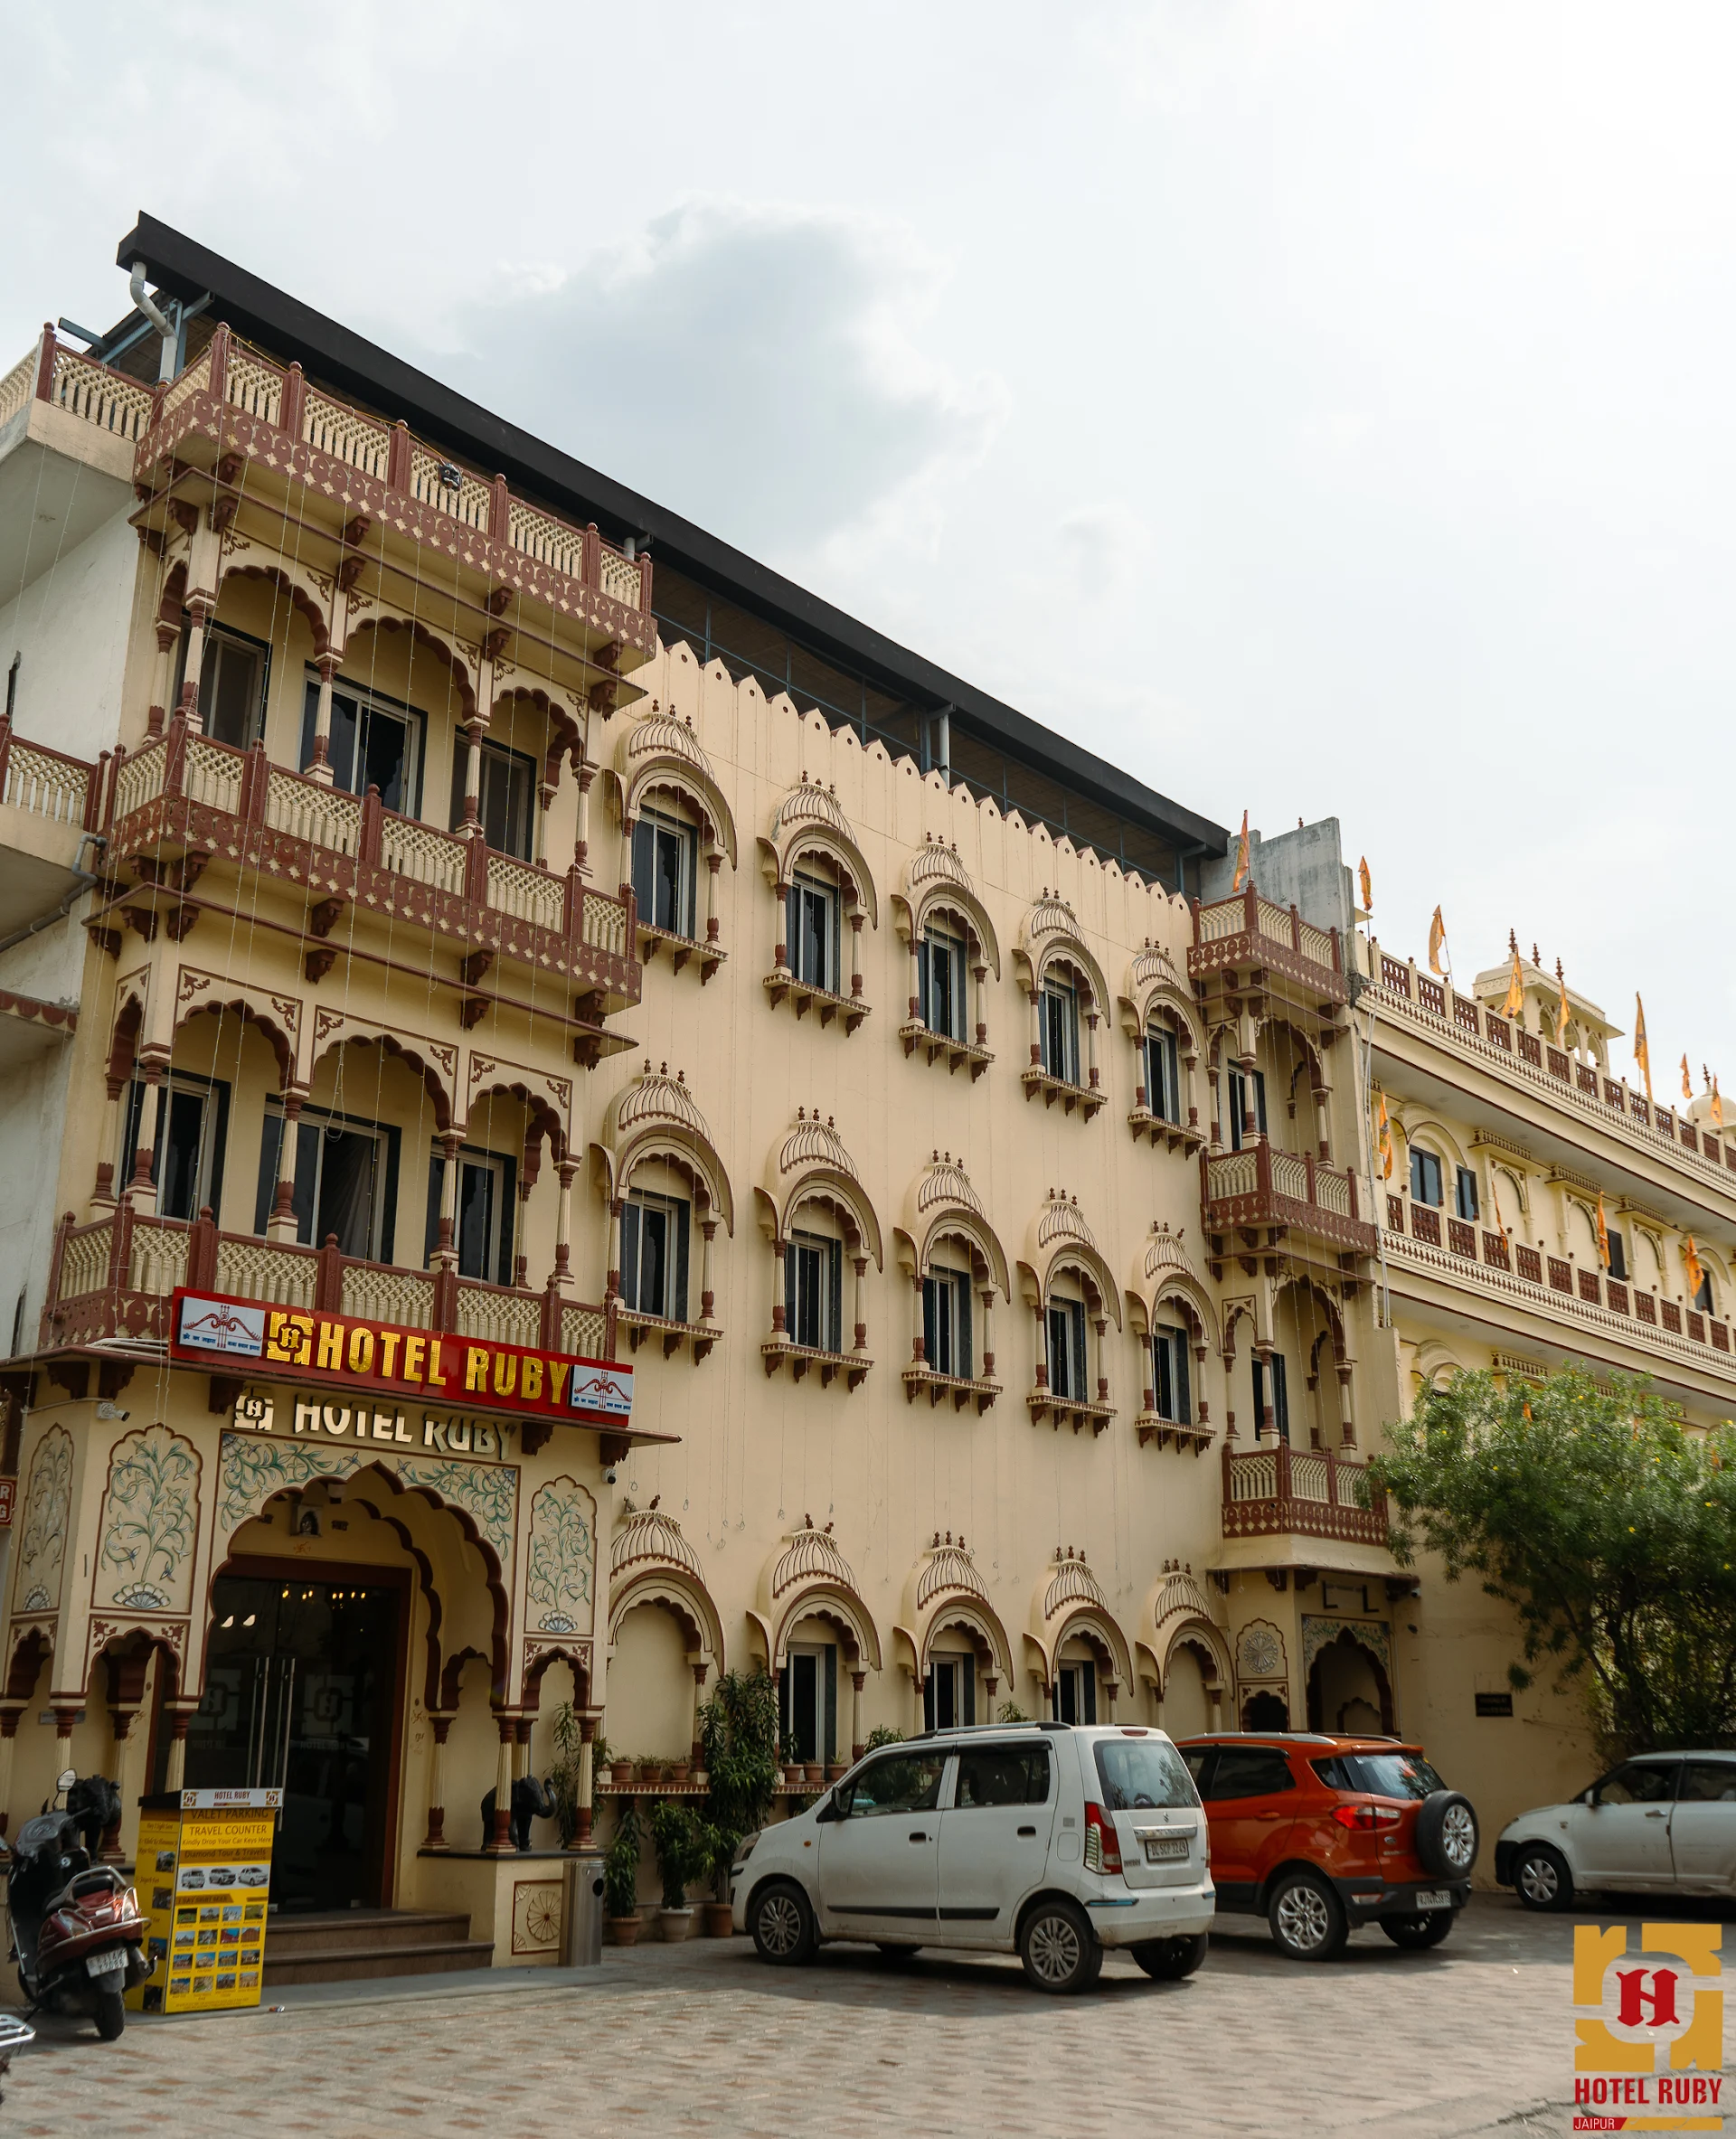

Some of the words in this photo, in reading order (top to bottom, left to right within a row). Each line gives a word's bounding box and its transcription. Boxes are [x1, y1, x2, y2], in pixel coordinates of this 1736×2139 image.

[316, 1321, 447, 1386] HOTEL
[465, 1346, 569, 1404] RUBY
[295, 1394, 413, 1443] HOTEL
[424, 1412, 516, 1461] RUBY
[214, 1791, 232, 1800] HOTEL
[233, 1791, 250, 1800] RUBY
[191, 1808, 222, 1820] VALET
[225, 1808, 269, 1819] PARKING
[190, 1825, 222, 1836] TRAVEL
[224, 1824, 267, 1835] COUNTER
[182, 1839, 200, 1847] Kindly
[202, 1838, 216, 1846] Drop
[243, 1837, 257, 1845] Keys
[184, 1850, 216, 1859] Diamond
[218, 1849, 234, 1857] Tour
[235, 1848, 241, 1856] &
[242, 1847, 266, 1856] Travels
